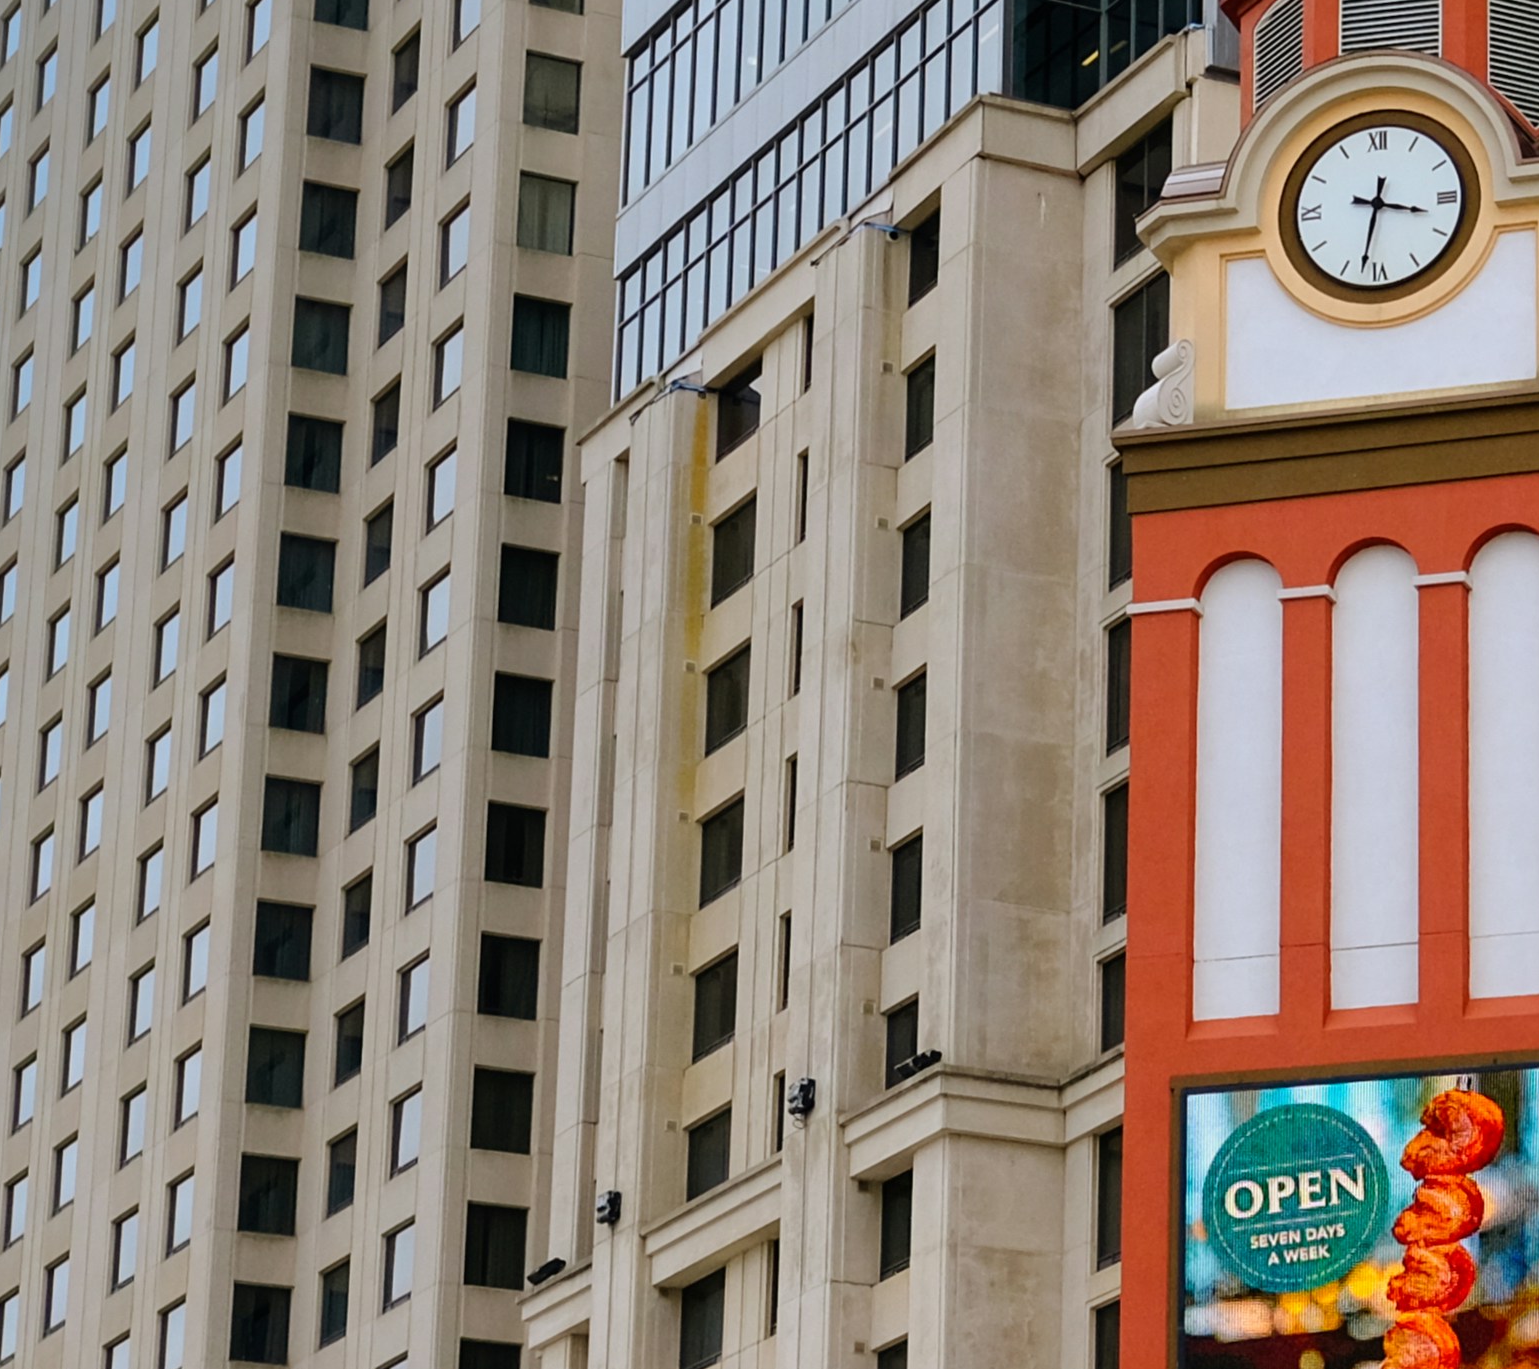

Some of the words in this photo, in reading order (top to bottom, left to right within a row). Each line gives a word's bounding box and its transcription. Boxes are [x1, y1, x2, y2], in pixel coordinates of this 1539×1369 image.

[1367, 130, 1388, 153] XII
[1224, 1163, 1366, 1220] OPEN
[1250, 1229, 1301, 1250] SEVEN
[1306, 1223, 1346, 1241] DAYS
[1267, 1251, 1280, 1267] A
[1283, 1244, 1331, 1264] WEEK
